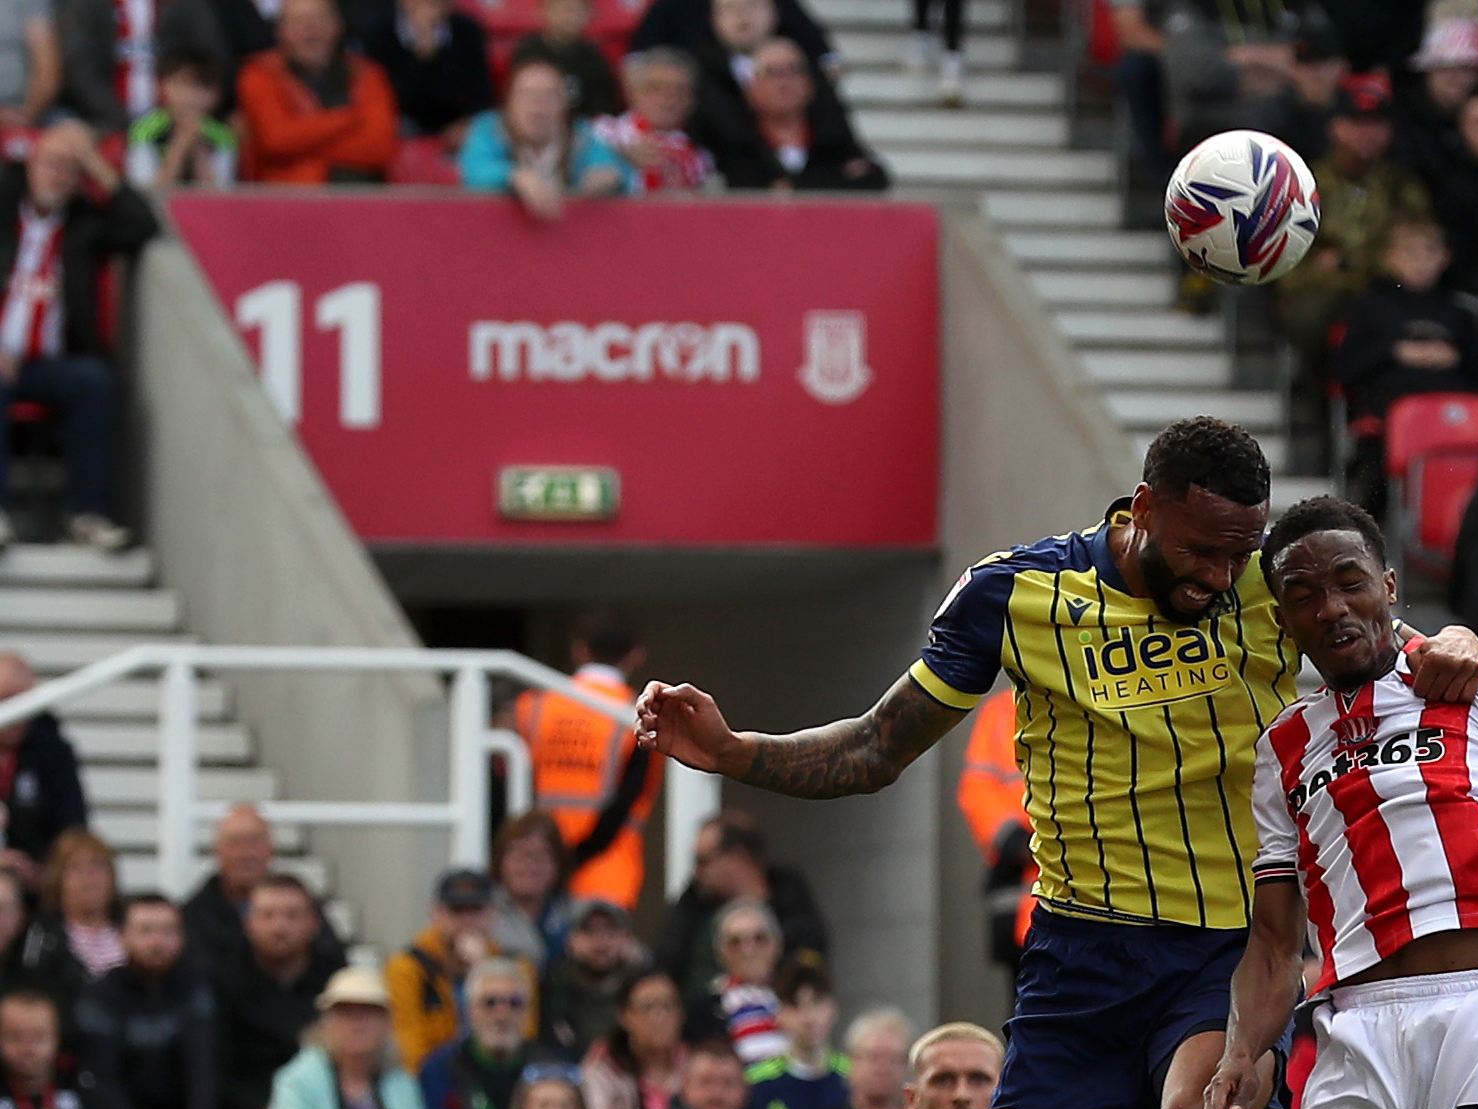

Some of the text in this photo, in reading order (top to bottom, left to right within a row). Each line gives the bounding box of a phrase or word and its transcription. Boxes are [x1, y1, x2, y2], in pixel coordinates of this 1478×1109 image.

[235, 278, 382, 430] 11
[468, 320, 763, 383] macron
[1078, 626, 1226, 680] ideal
[1091, 663, 1229, 702] HEATING
